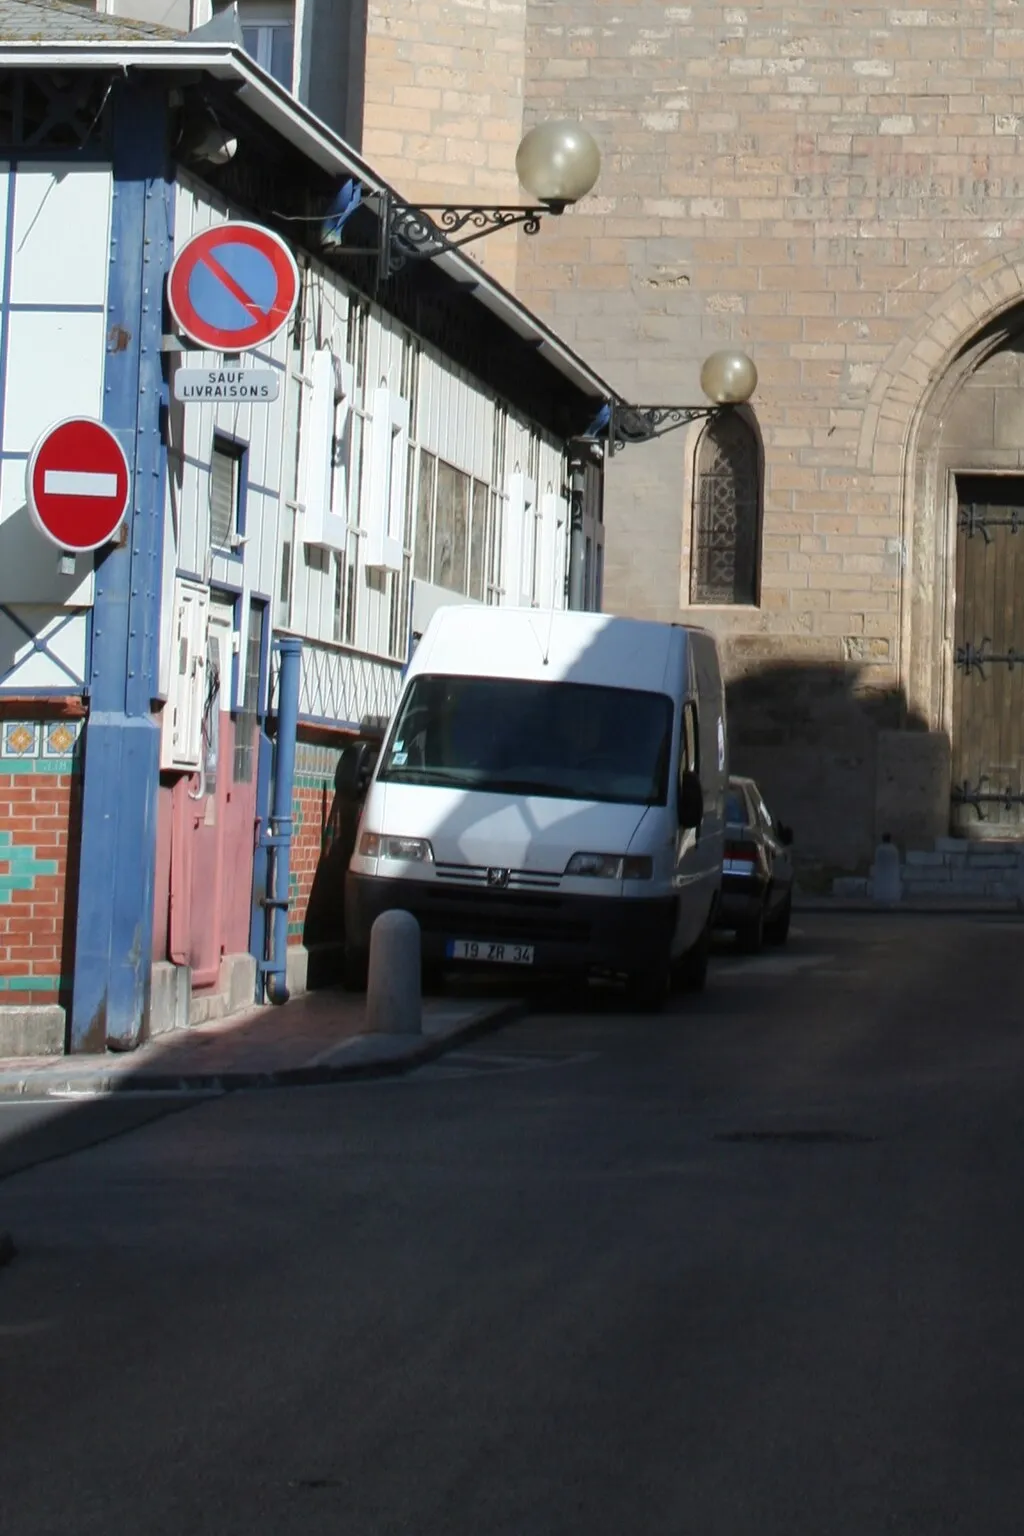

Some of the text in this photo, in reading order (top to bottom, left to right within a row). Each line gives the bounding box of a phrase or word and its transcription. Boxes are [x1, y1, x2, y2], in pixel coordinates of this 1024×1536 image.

[208, 372, 245, 383] SAUF
[183, 386, 269, 397] LIVRAISONS
[512, 946, 531, 962] 34
